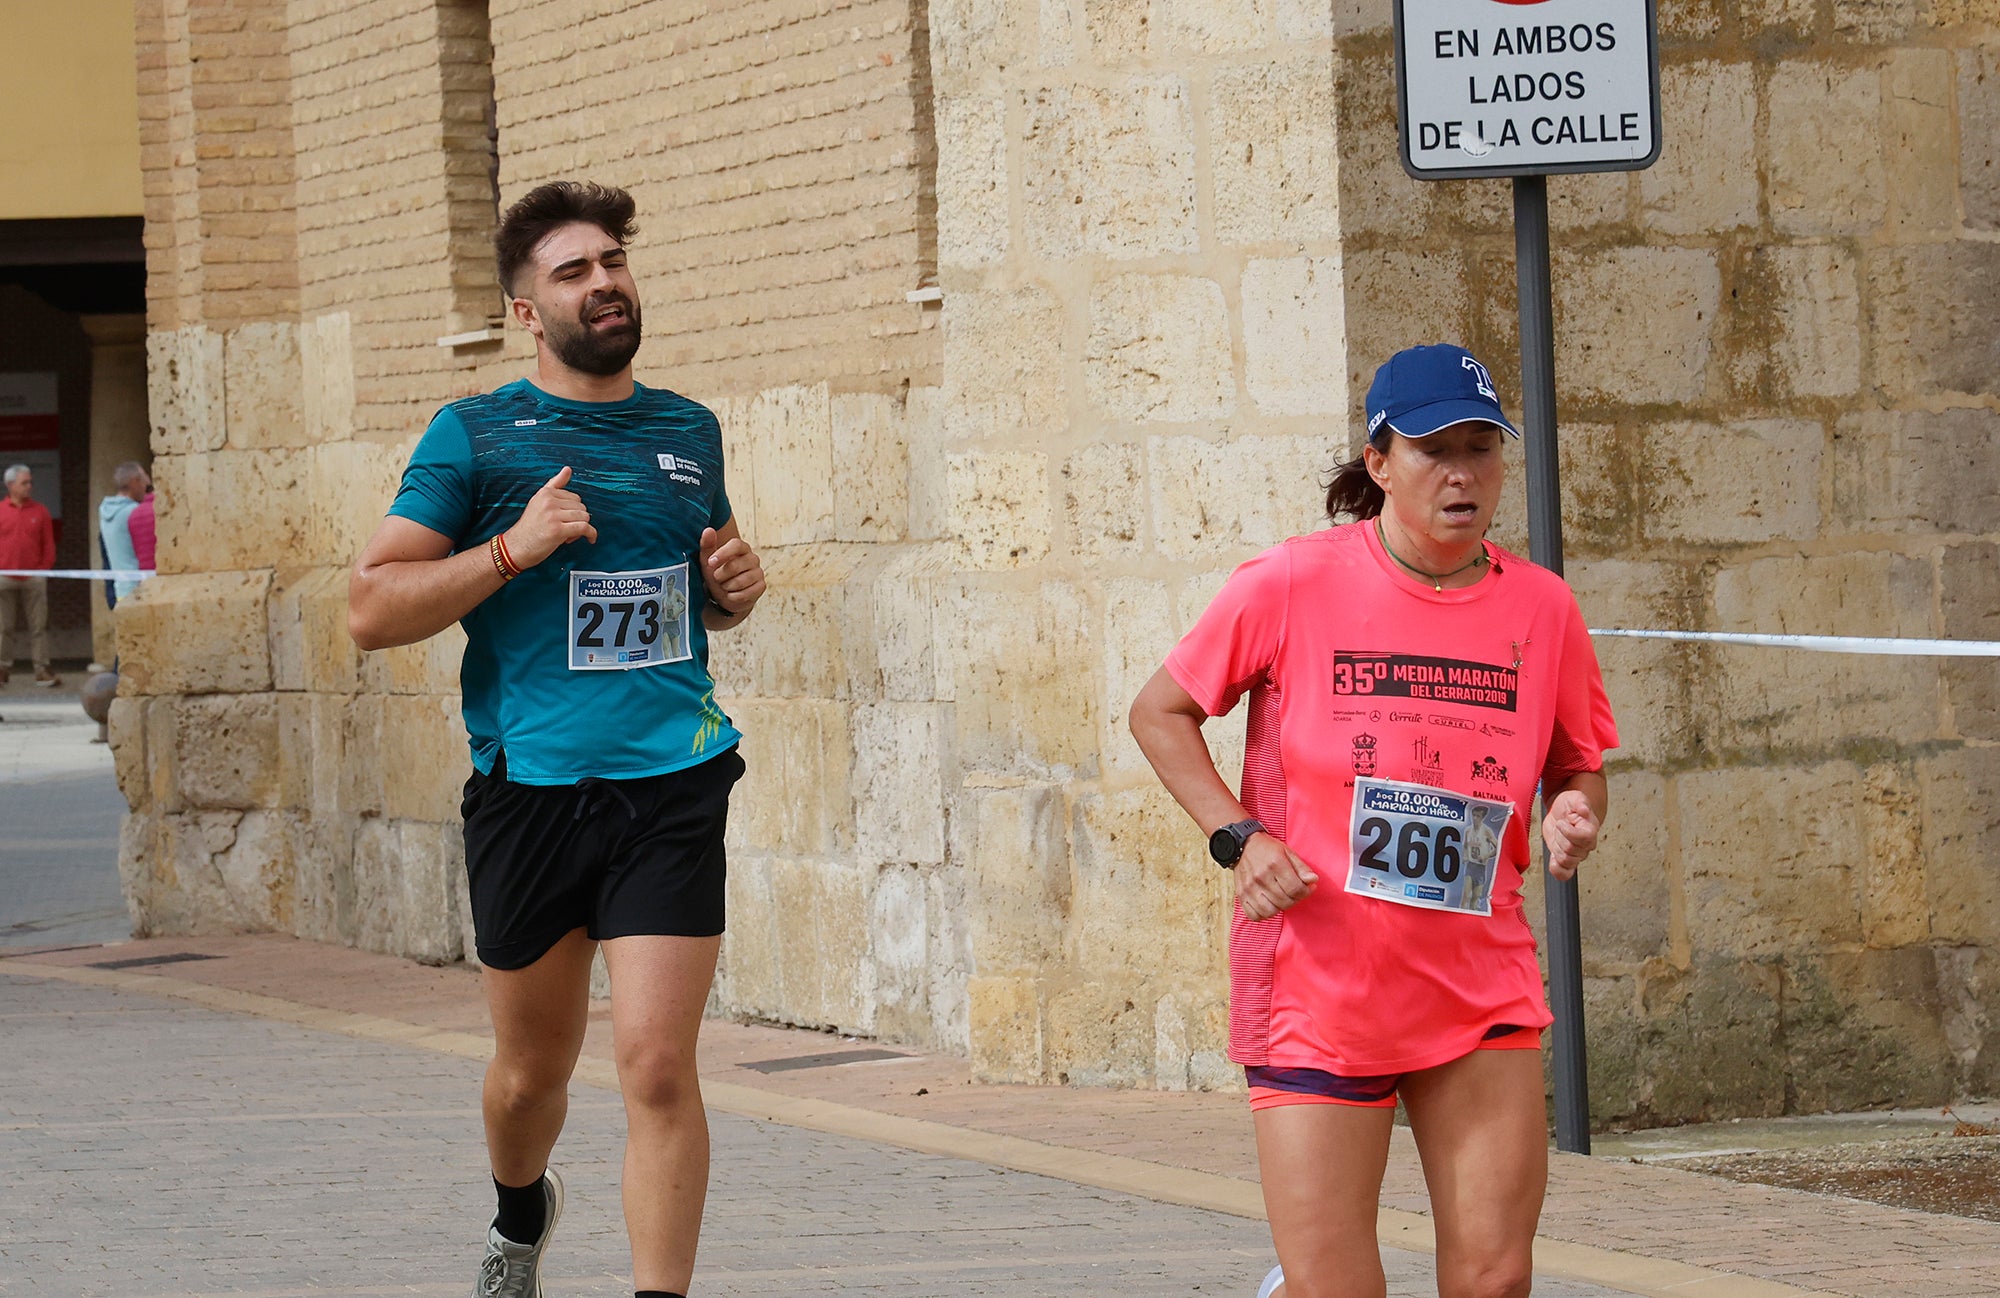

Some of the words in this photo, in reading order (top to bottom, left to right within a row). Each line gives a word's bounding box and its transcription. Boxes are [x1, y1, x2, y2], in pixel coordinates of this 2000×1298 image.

[1434, 29, 1479, 59] EN
[1492, 22, 1617, 57] AMBOS
[1469, 71, 1586, 104] LADOS
[1419, 121, 1463, 151] DE
[1476, 118, 1521, 148] LA
[1531, 112, 1640, 146] CALLE
[670, 472, 701, 486] deportes
[584, 588, 631, 596] MARIANO
[632, 586, 657, 595] HARO
[601, 578, 642, 589] 10.000
[576, 599, 660, 648] 273
[1393, 664, 1446, 684] MEDIA
[1448, 667, 1517, 692] MARATÓN
[1410, 685, 1432, 698] DEL
[1434, 686, 1484, 703] CERRATO
[1484, 689, 1507, 705] 2019
[1371, 800, 1428, 815] MARIANO
[1429, 807, 1459, 819] HARO
[1393, 791, 1441, 808] 10.000
[1358, 816, 1462, 884] 266
